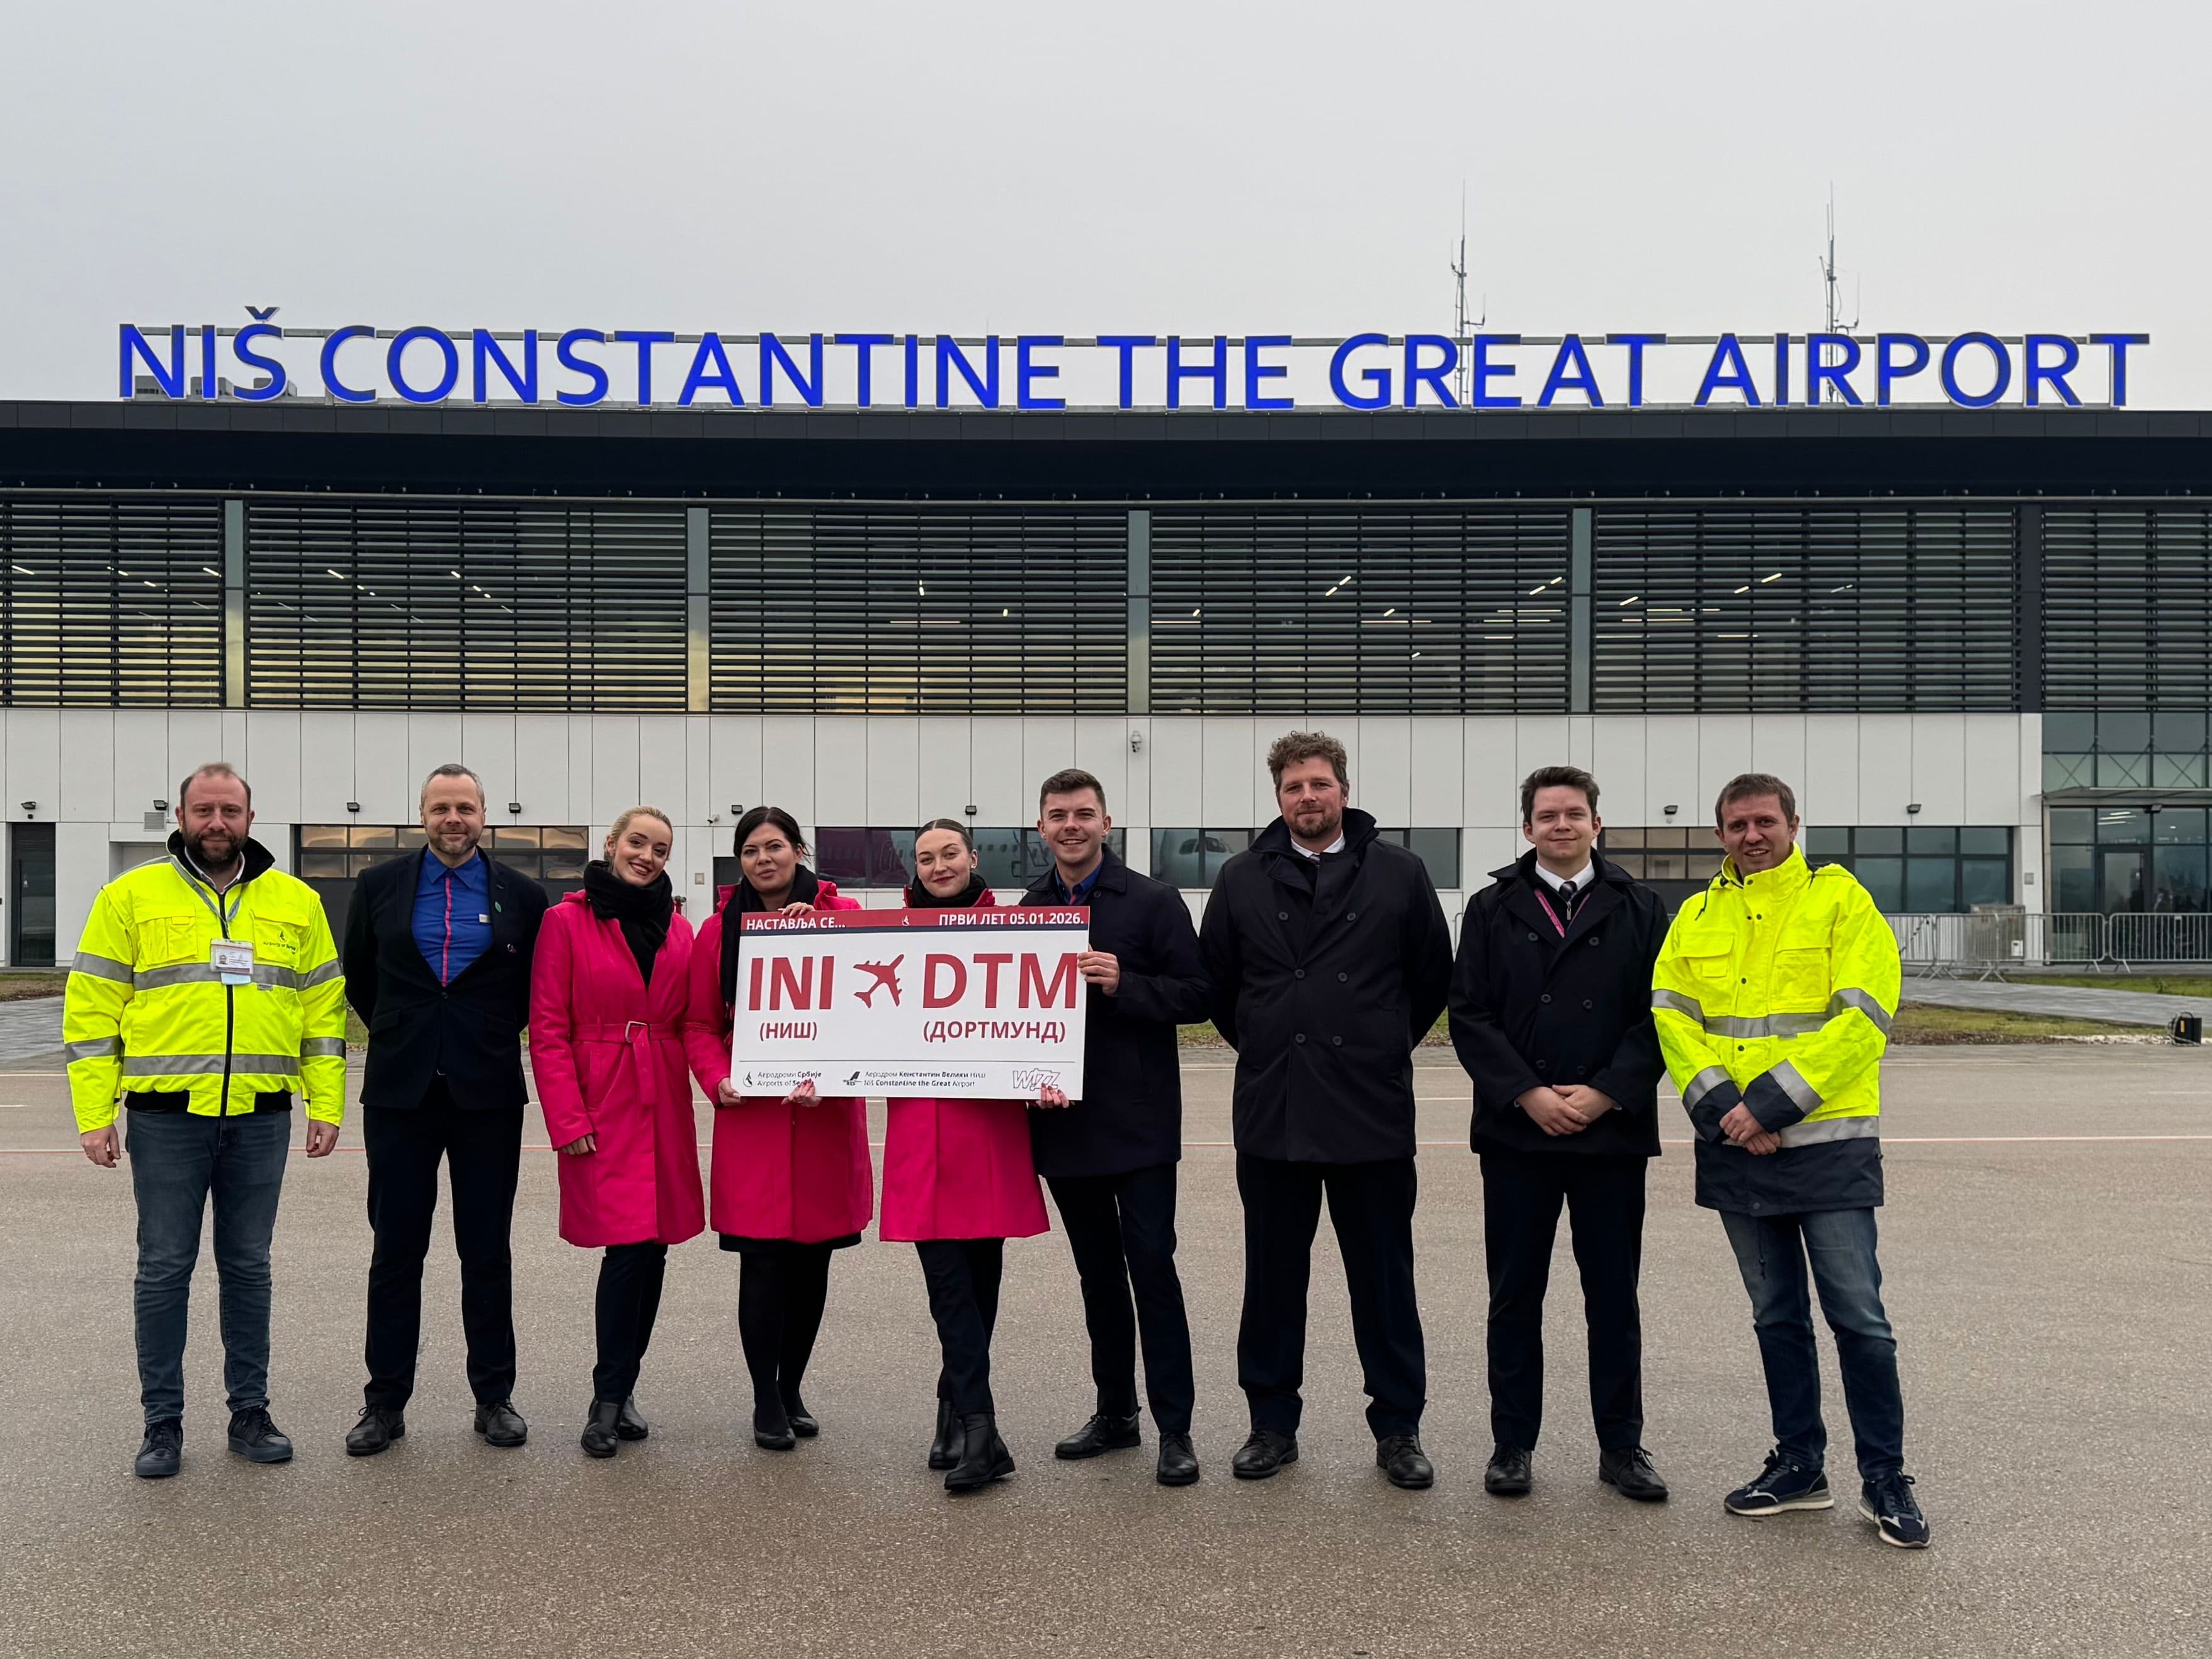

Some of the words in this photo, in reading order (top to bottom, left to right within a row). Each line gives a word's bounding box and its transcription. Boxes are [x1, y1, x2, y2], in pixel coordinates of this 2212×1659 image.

[119, 305, 286, 402] NIŠ
[320, 325, 1066, 411] CONSTANTINE
[1096, 335, 1295, 411] THE
[1329, 333, 1667, 411] GREAT
[1693, 332, 2150, 409] AIRPORT
[746, 917, 817, 930] НАСТАВЉА
[820, 916, 846, 929] СЕ...
[939, 914, 977, 926] ПРВИ
[980, 913, 1006, 926] ЛЕТ
[1009, 912, 1084, 925] 05.01.2026.
[748, 955, 835, 1011] INI
[922, 953, 1079, 1009] DTM
[759, 1021, 818, 1041] (НИШ)
[923, 1021, 1066, 1043] (ДОРТМУНД)
